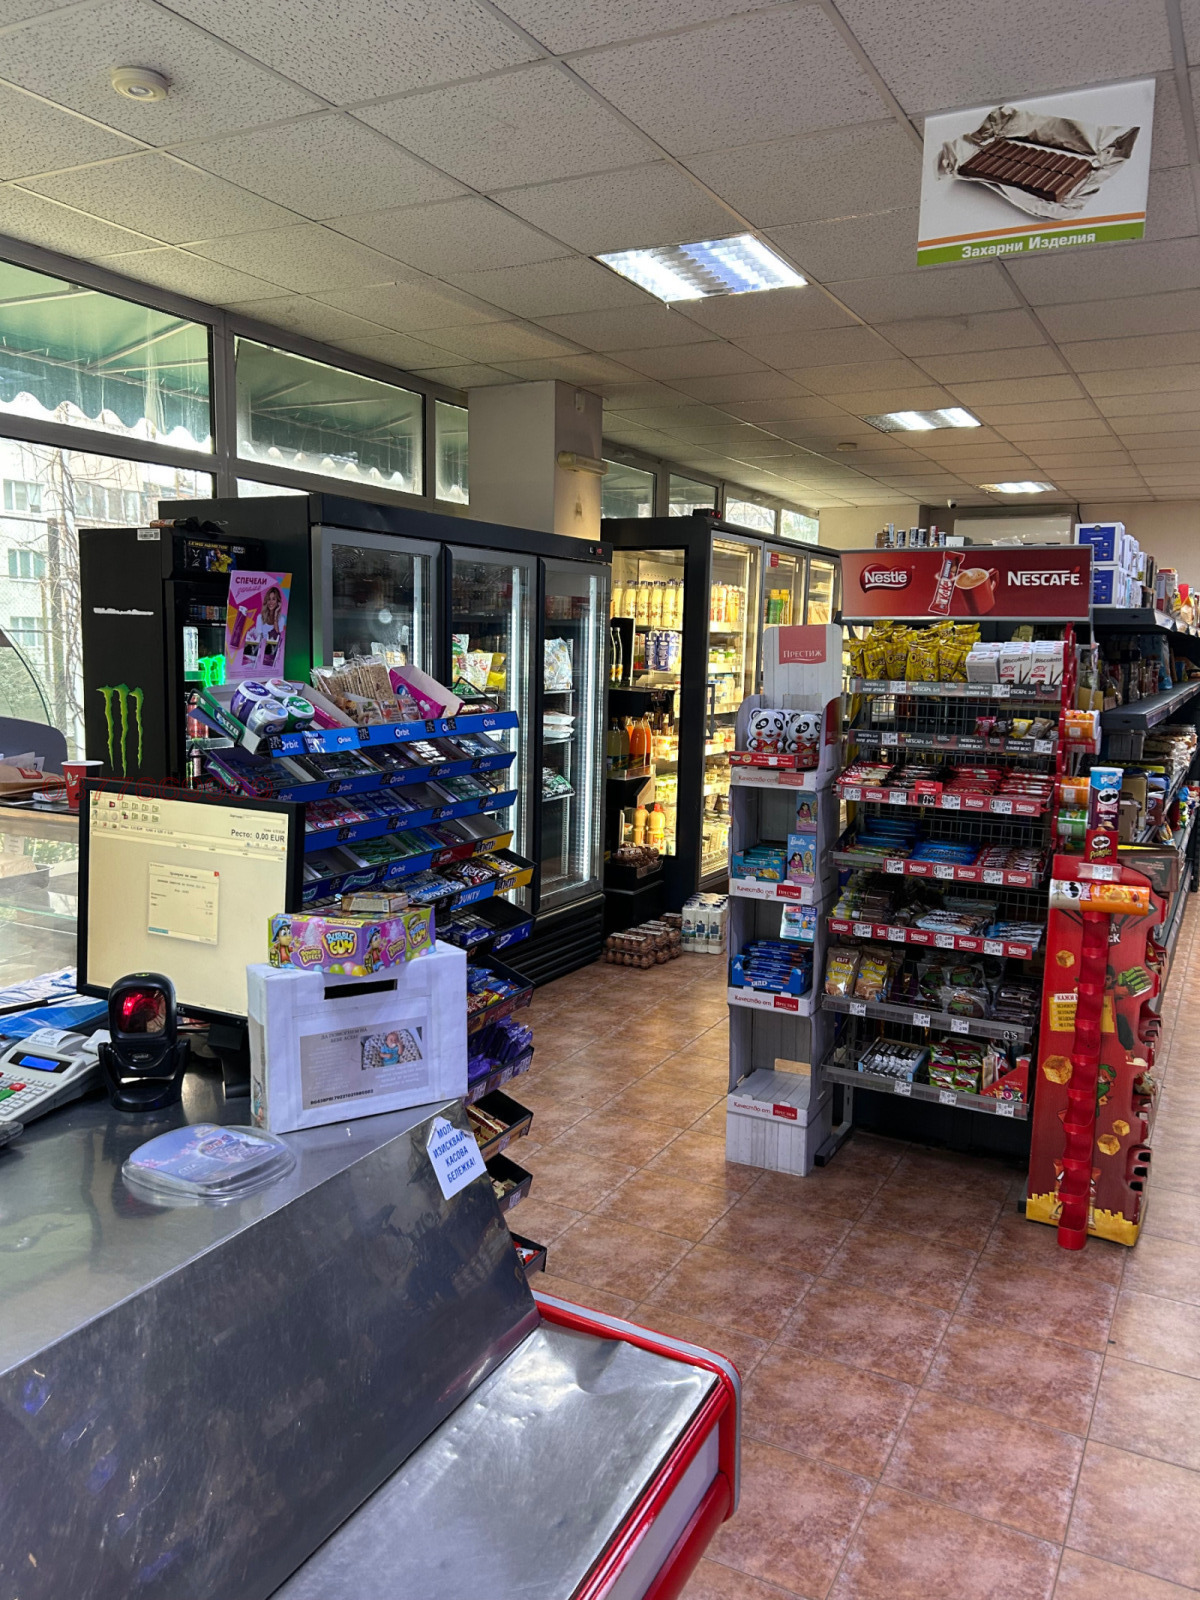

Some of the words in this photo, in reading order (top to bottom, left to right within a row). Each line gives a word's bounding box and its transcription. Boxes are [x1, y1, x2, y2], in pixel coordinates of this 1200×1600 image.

[961, 242, 1023, 258] Захарни
[1028, 233, 1096, 250] Изделия
[235, 577, 268, 586] СПЕЧЕЛИ
[1007, 567, 1080, 586] NESCAFÉ
[783, 650, 823, 658] ПРЕСТИЖ
[484, 719, 496, 727] Orbit
[395, 728, 410, 737] Orbit
[338, 736, 352, 744] Orbit
[437, 768, 450, 776] Orbit
[389, 775, 405, 784] Orbit
[231, 829, 253, 839] Ресто:
[270, 834, 285, 843] EUR
[1089, 849, 1112, 860] Pringles
[391, 865, 405, 874] Orbit
[326, 931, 354, 944] BUBBLE
[329, 941, 355, 955] GUM
[437, 1123, 453, 1139] МОЛ
[445, 1146, 468, 1167] КАСОВА
[447, 1157, 476, 1183] БЕЛЕЖКА!
